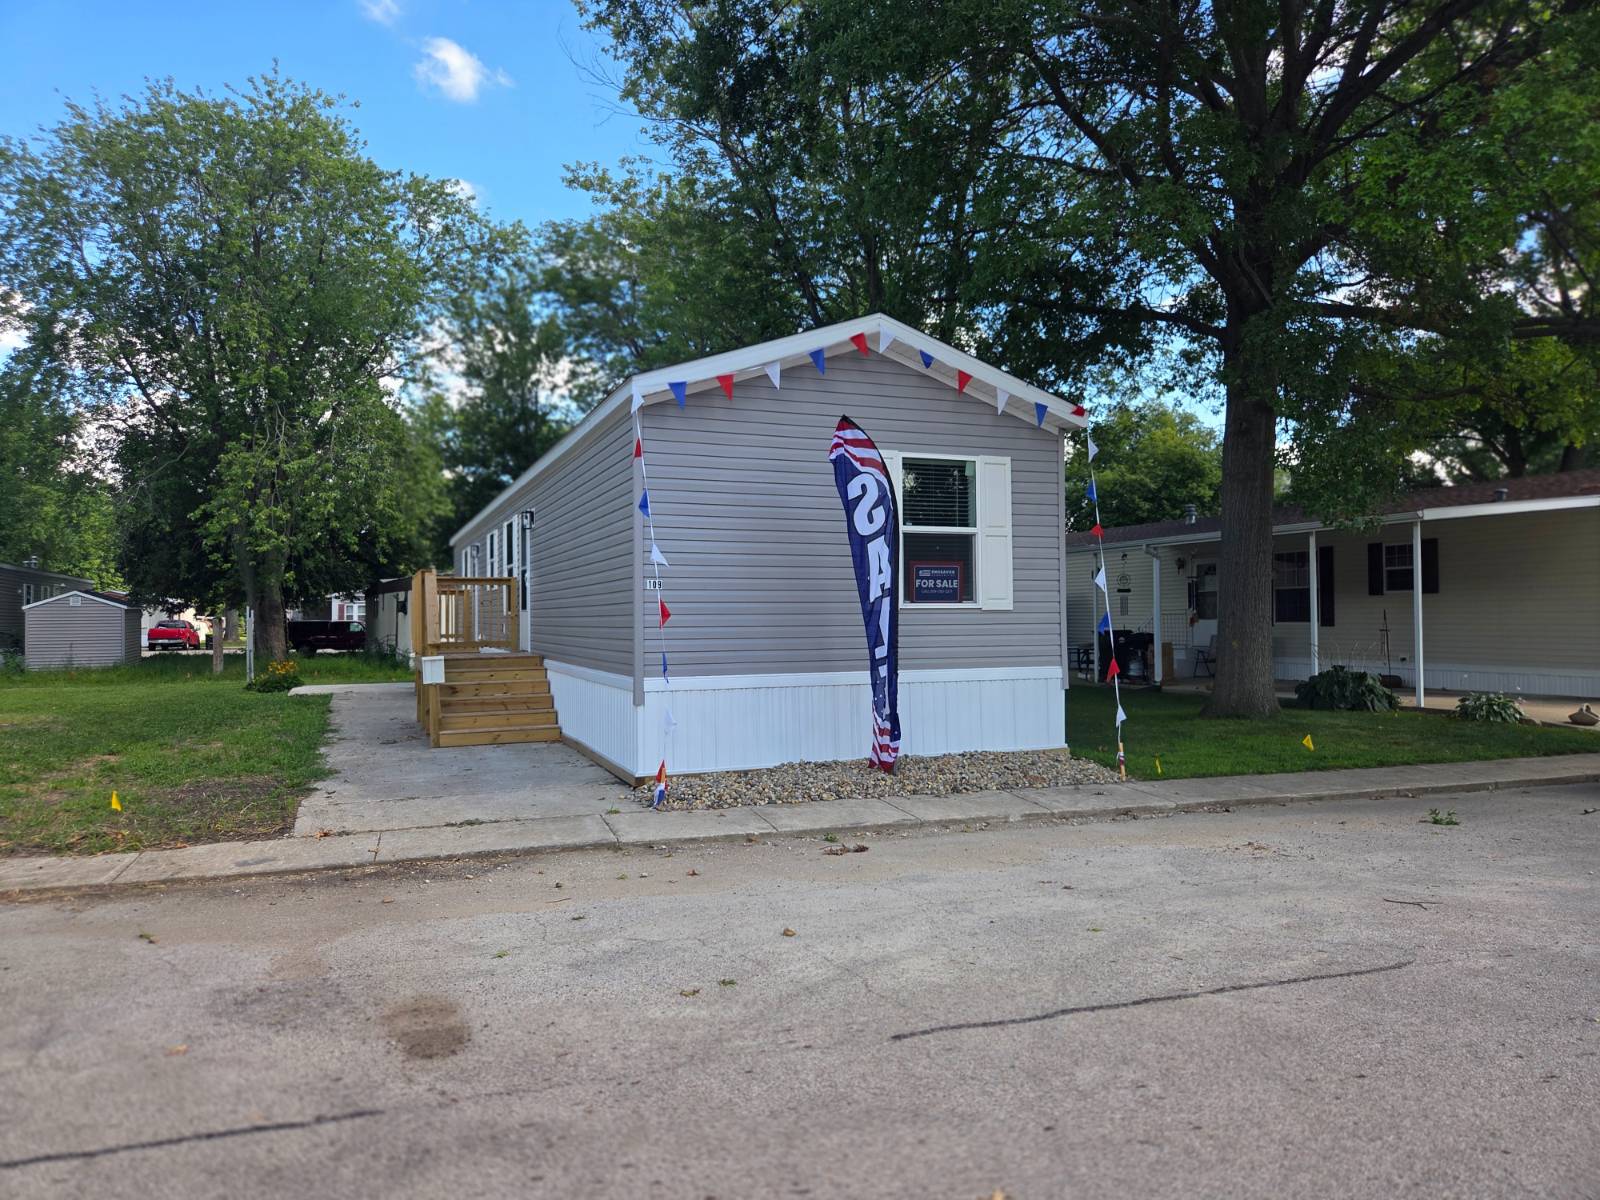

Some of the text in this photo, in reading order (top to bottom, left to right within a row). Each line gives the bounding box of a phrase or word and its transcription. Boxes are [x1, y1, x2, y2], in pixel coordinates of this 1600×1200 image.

[648, 580, 662, 589] 109
[915, 579, 959, 588] FOR SALE
